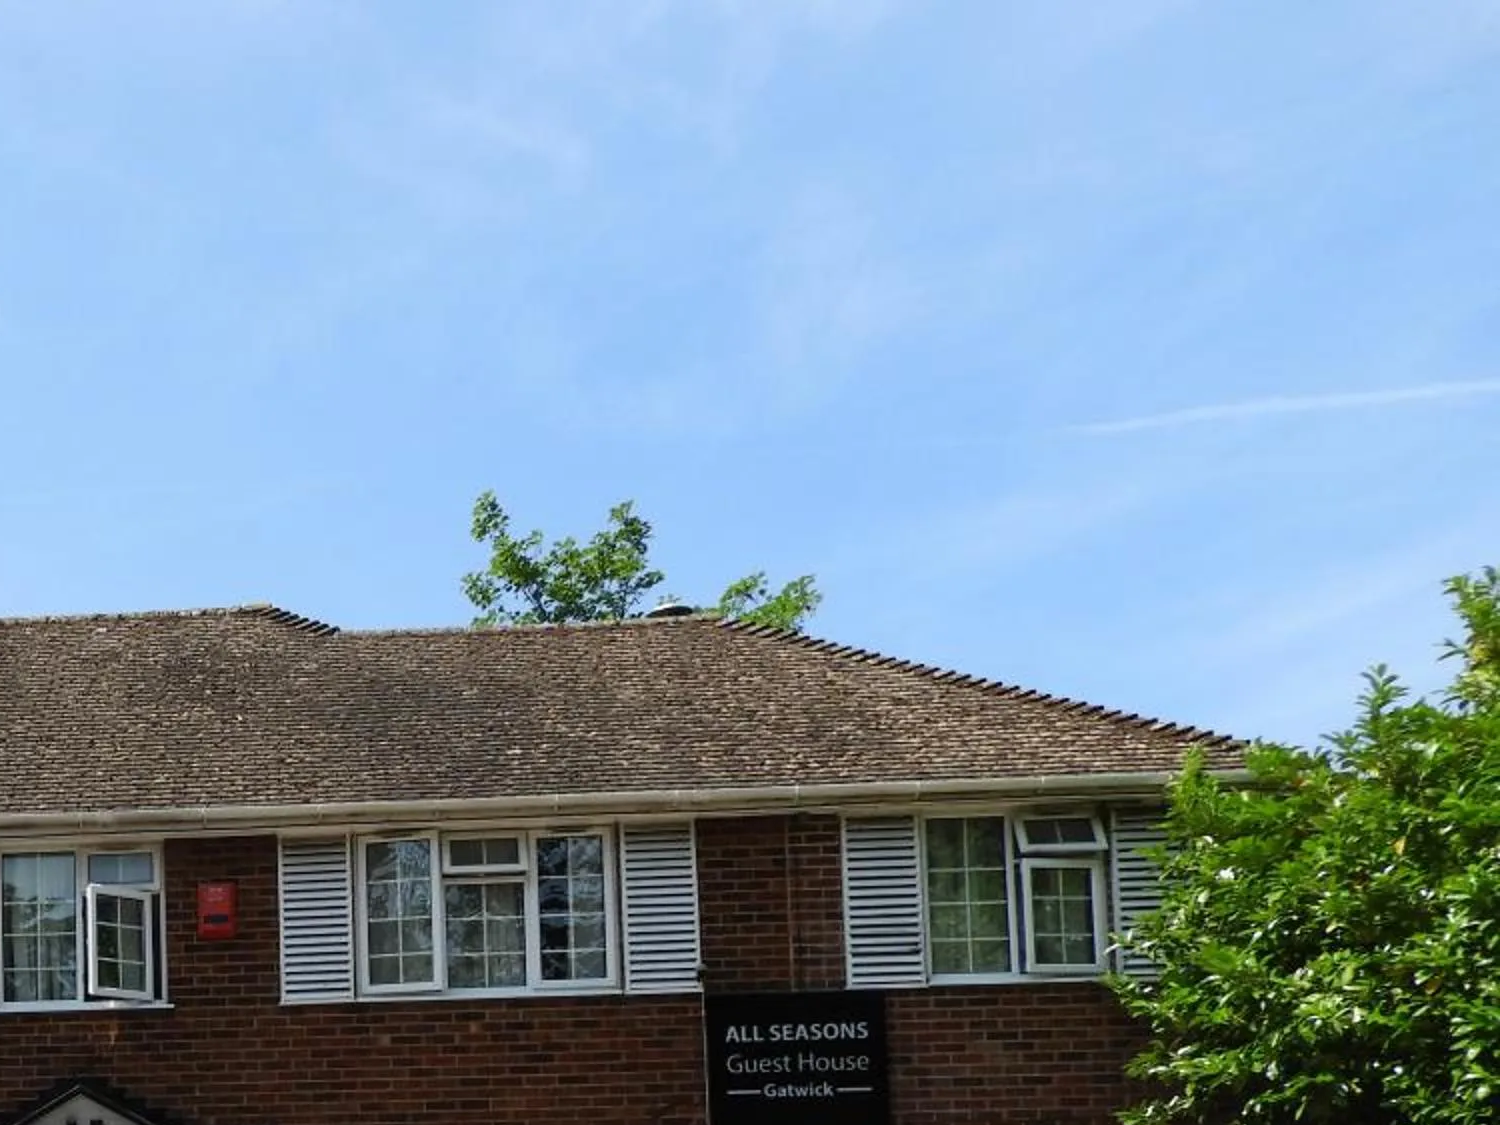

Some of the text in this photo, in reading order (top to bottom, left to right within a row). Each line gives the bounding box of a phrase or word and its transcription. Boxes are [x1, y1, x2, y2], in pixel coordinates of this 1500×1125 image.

[725, 1022, 869, 1043] ALL SEASONS
[726, 1052, 870, 1073] Guest House
[763, 1081, 834, 1098] Gatwick
